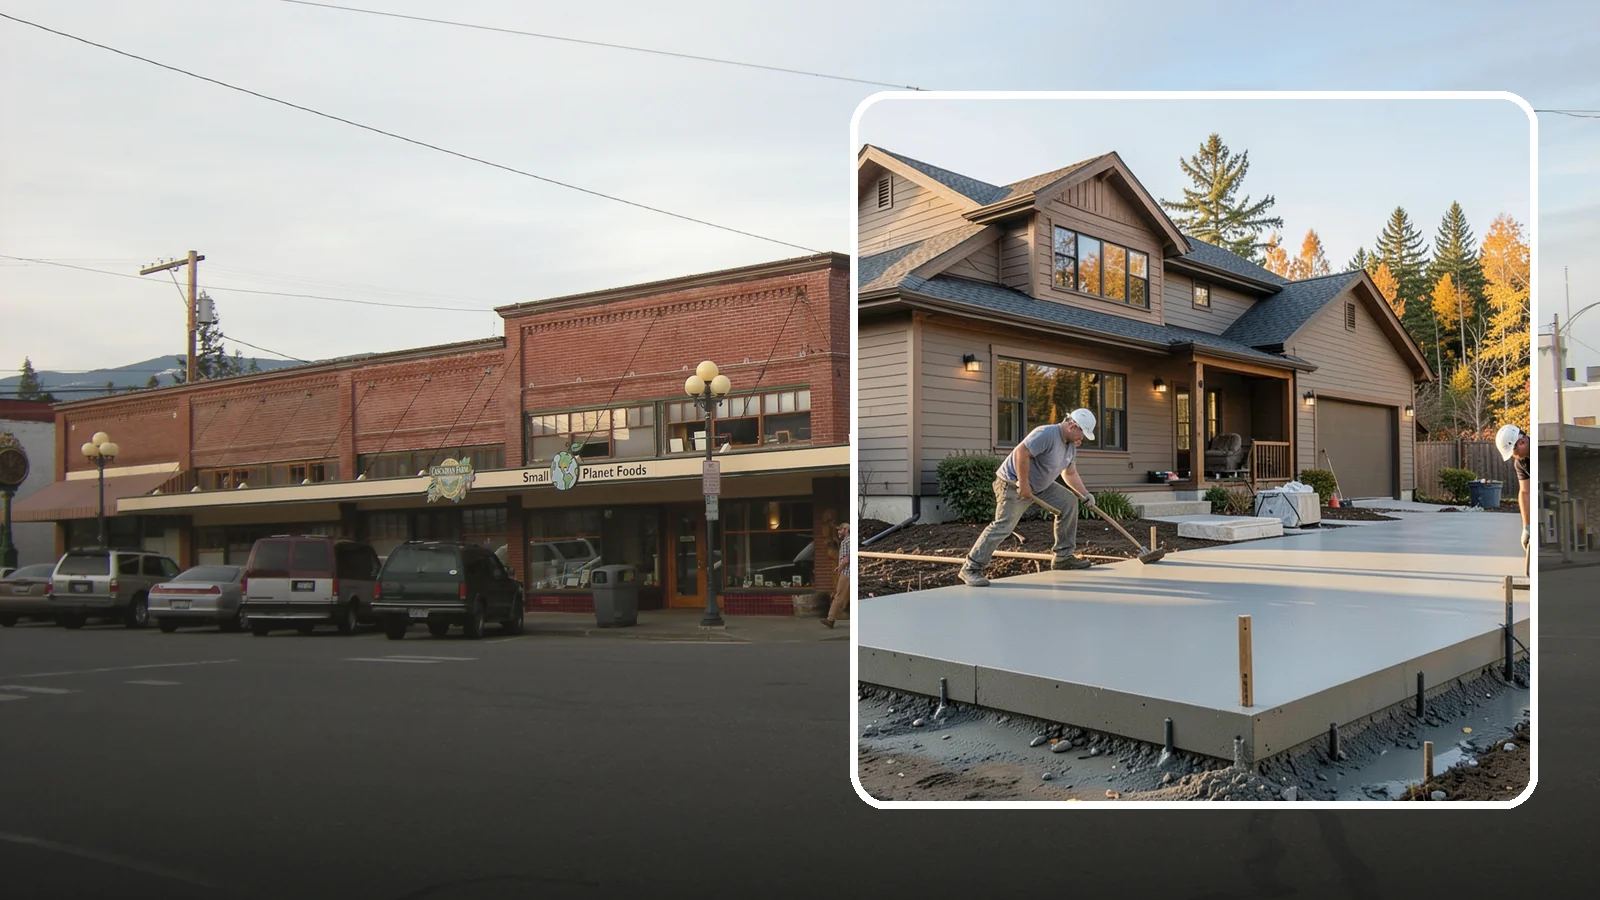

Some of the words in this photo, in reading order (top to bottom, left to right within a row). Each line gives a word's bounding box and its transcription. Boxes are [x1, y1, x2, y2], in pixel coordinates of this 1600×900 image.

[523, 471, 549, 483] Small
[583, 467, 614, 479] Planet
[616, 464, 647, 476] Foods
